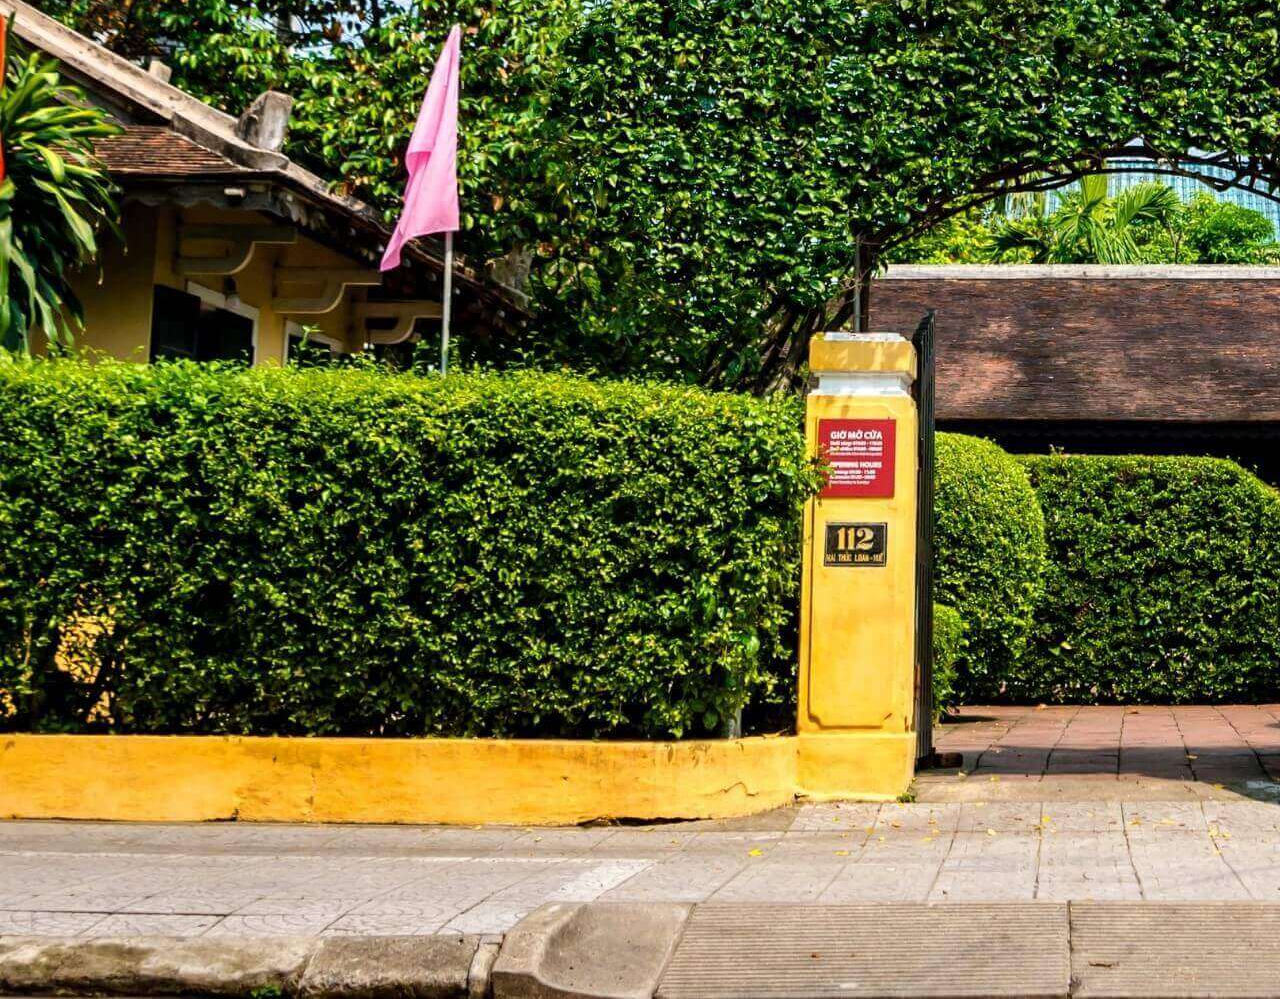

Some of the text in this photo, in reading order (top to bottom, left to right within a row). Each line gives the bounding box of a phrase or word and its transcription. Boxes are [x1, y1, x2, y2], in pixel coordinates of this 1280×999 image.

[830, 429, 882, 440] GIỜ MỞ CỬA
[838, 527, 874, 550] 112
